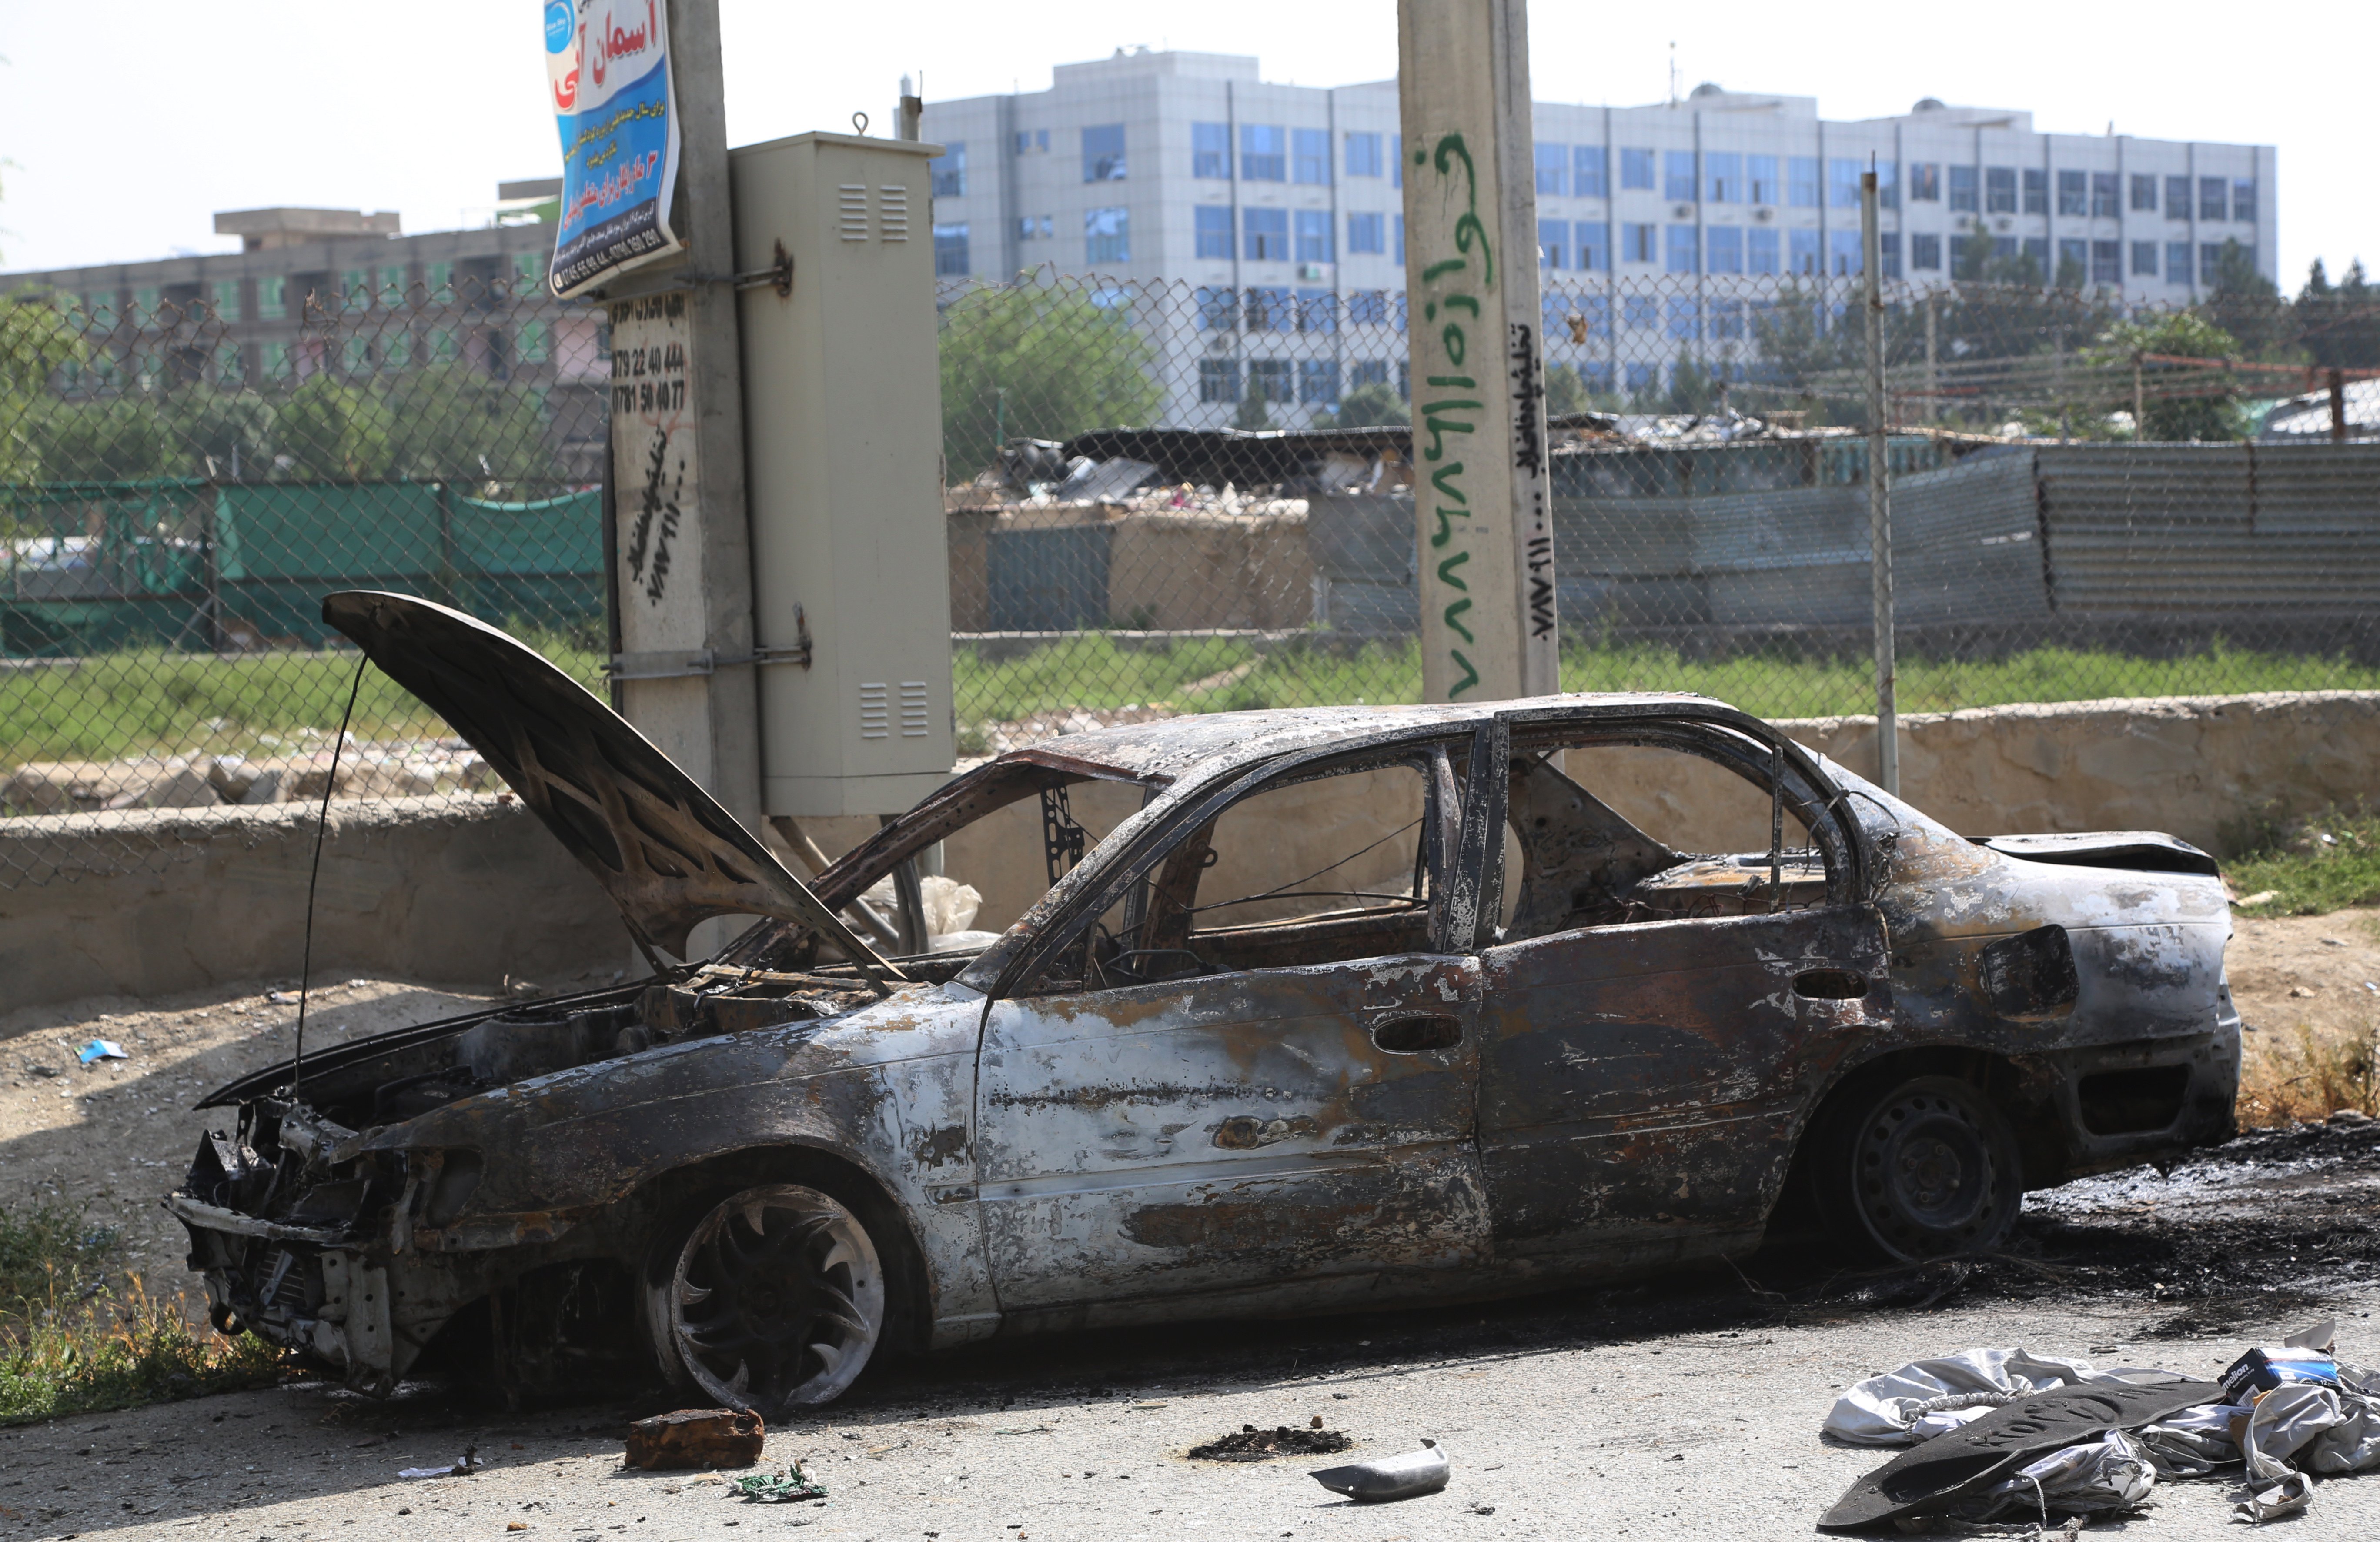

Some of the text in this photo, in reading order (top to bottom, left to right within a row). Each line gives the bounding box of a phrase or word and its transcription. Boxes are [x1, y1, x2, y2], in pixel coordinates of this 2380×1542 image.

[598, 172, 615, 207] برای
[632, 347, 645, 376] 22
[648, 346, 661, 375] 40
[664, 343, 684, 373] 444
[612, 384, 636, 414] 0781
[641, 382, 654, 412] 50
[672, 379, 685, 410] 77
